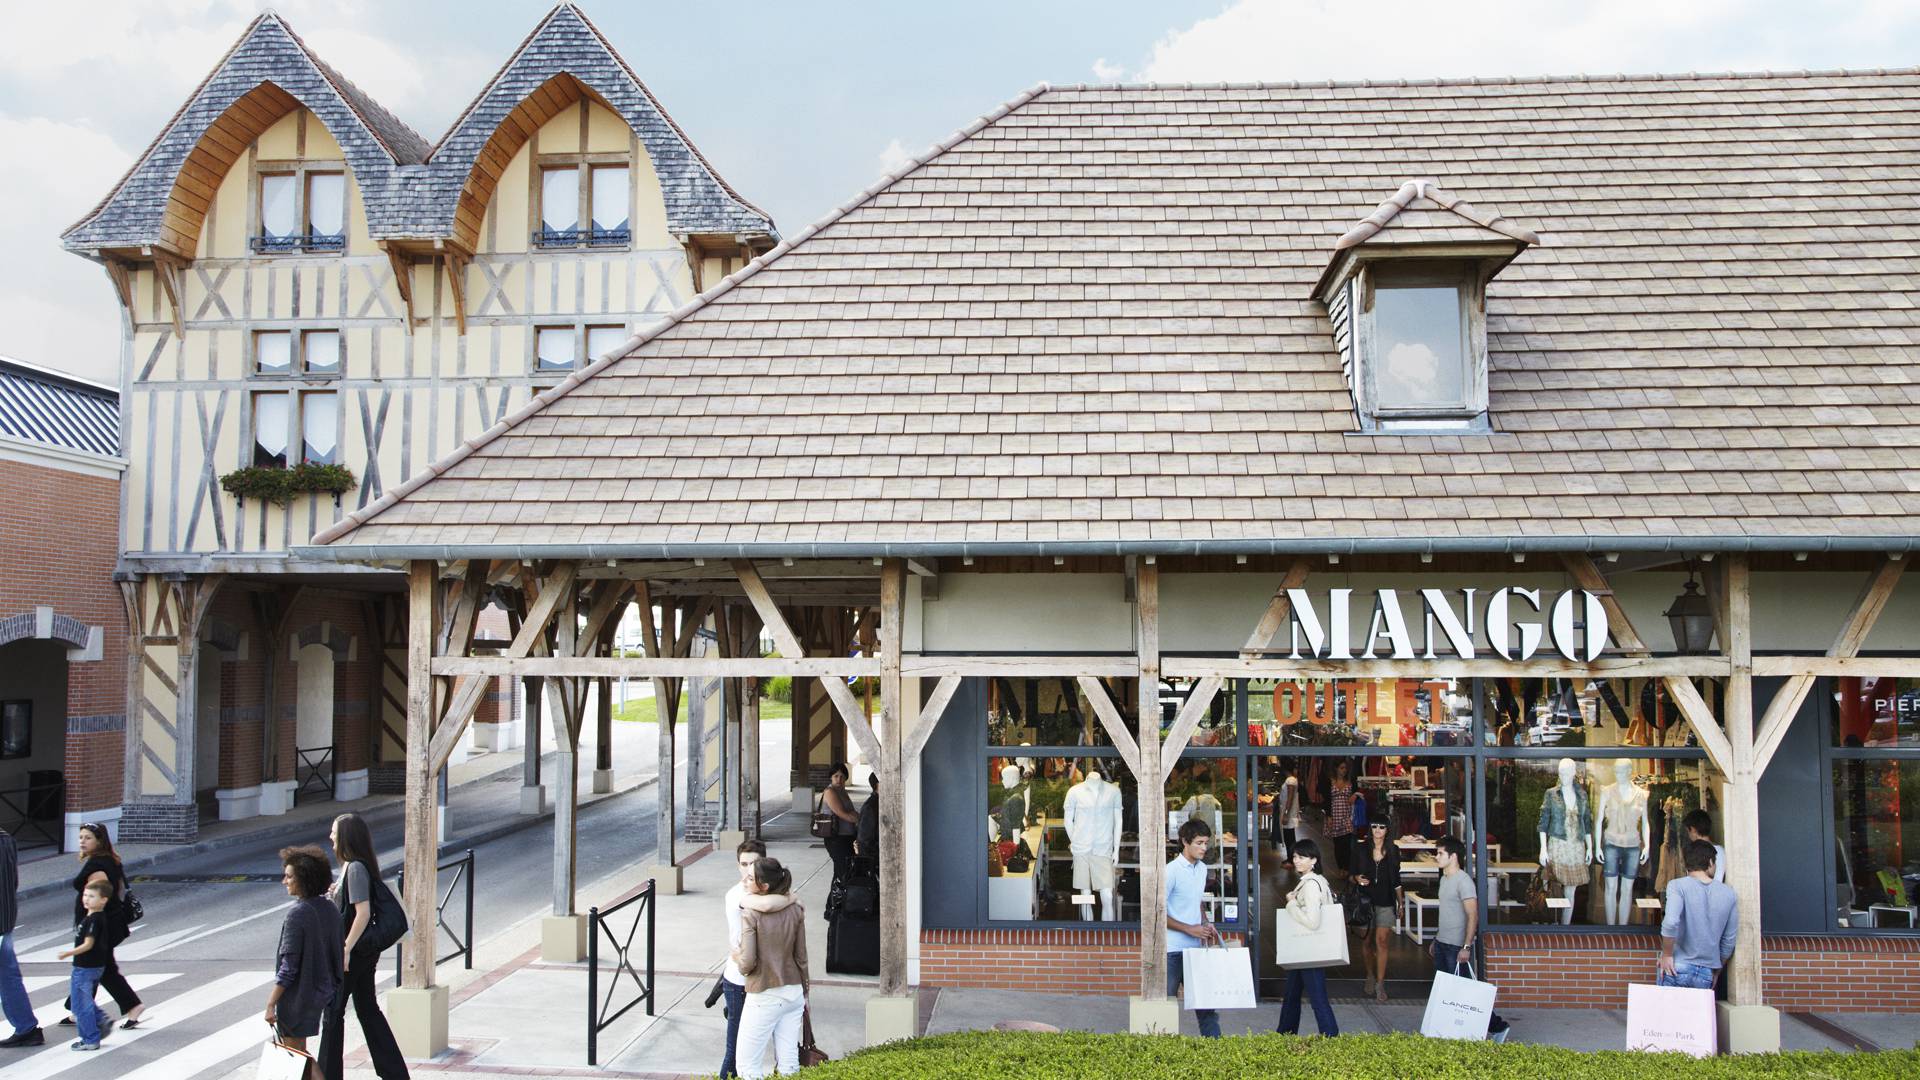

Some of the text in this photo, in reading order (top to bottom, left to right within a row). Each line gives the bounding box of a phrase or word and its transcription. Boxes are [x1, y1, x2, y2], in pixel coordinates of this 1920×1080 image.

[1286, 586, 1609, 662] MANGO
[1272, 680, 1450, 726] OUTLET
[1442, 1000, 1484, 1014] LANCEL
[1643, 1028, 1695, 1041] Eden Park
